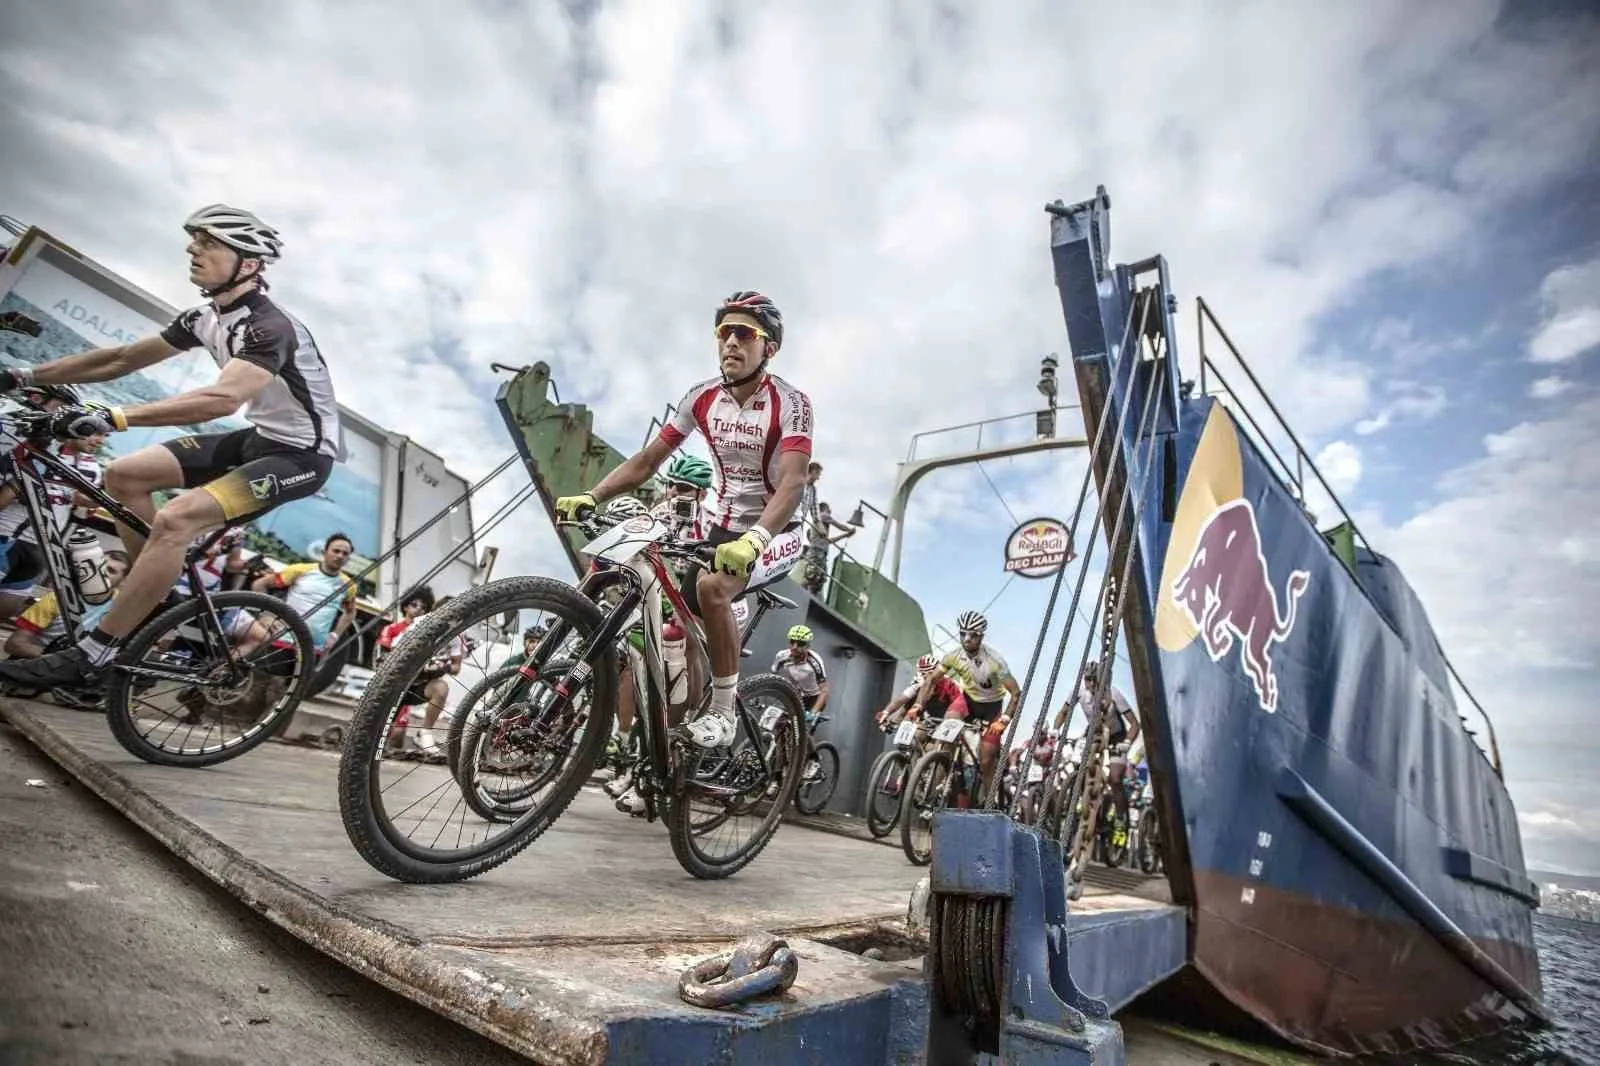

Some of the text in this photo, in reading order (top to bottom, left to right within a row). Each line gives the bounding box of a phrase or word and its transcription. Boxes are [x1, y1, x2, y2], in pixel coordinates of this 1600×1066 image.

[713, 418, 763, 437] Turkish
[713, 436, 763, 452] Champion
[1032, 553, 1071, 566] KALM
